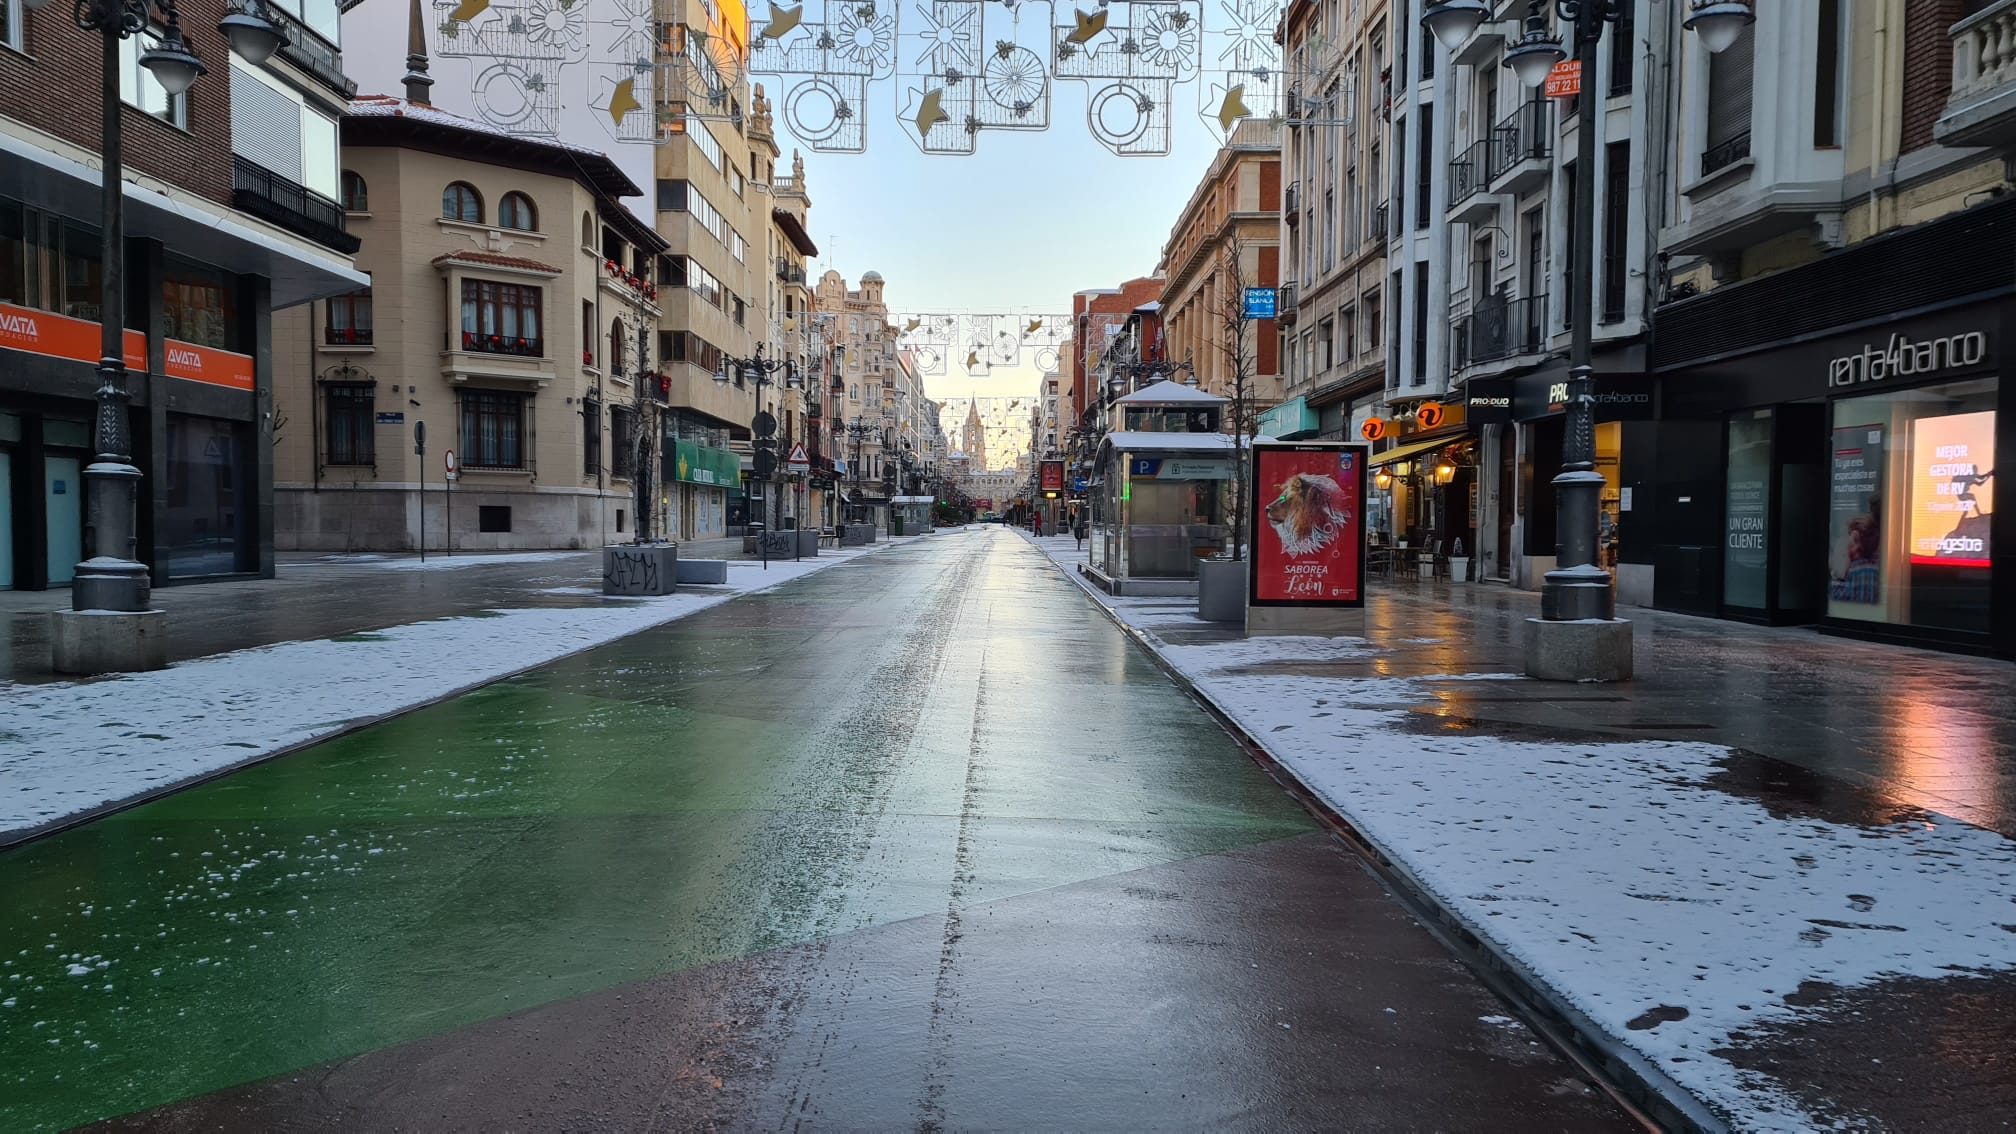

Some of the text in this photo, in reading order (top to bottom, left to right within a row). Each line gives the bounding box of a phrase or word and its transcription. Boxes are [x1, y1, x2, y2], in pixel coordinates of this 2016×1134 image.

[1552, 62, 1582, 72] LQUI
[1547, 81, 1561, 93] 987
[1562, 79, 1571, 91] 22
[0, 313, 38, 336] VATA
[167, 349, 202, 367] AVATA
[1828, 331, 1986, 387] renta4banco
[1593, 391, 1649, 403] nta4banco
[1936, 445, 1968, 460] MEJOR
[1140, 461, 1149, 474] P
[1929, 463, 1974, 477] GESTORA
[1937, 482, 1965, 495] DE RV
[1729, 517, 1764, 531] UN GRAN
[1729, 533, 1763, 549] CLIENTE
[1284, 564, 1329, 574] SABOREA
[1284, 575, 1325, 596] León
